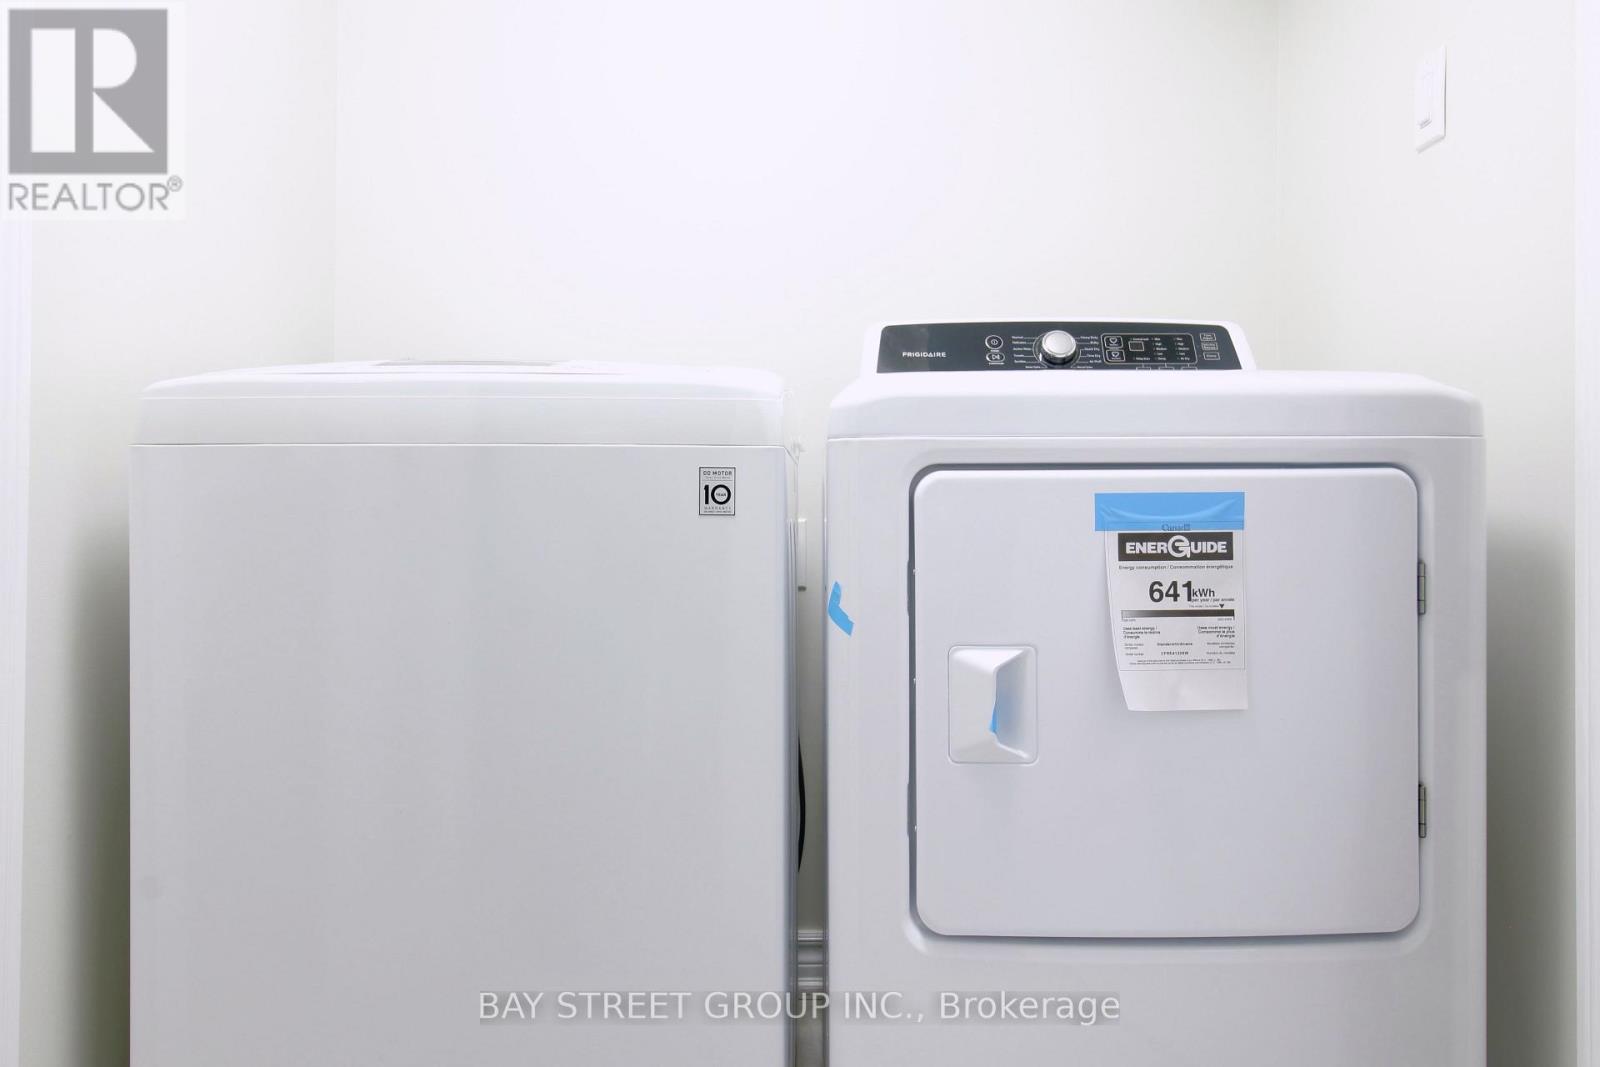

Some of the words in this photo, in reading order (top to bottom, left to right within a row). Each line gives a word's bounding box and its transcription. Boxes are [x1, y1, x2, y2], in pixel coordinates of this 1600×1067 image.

[704, 484, 732, 505] 10
[1125, 534, 1228, 558] ENERGUIDE
[1149, 580, 1192, 603] 641
[1192, 588, 1215, 598] kWh
